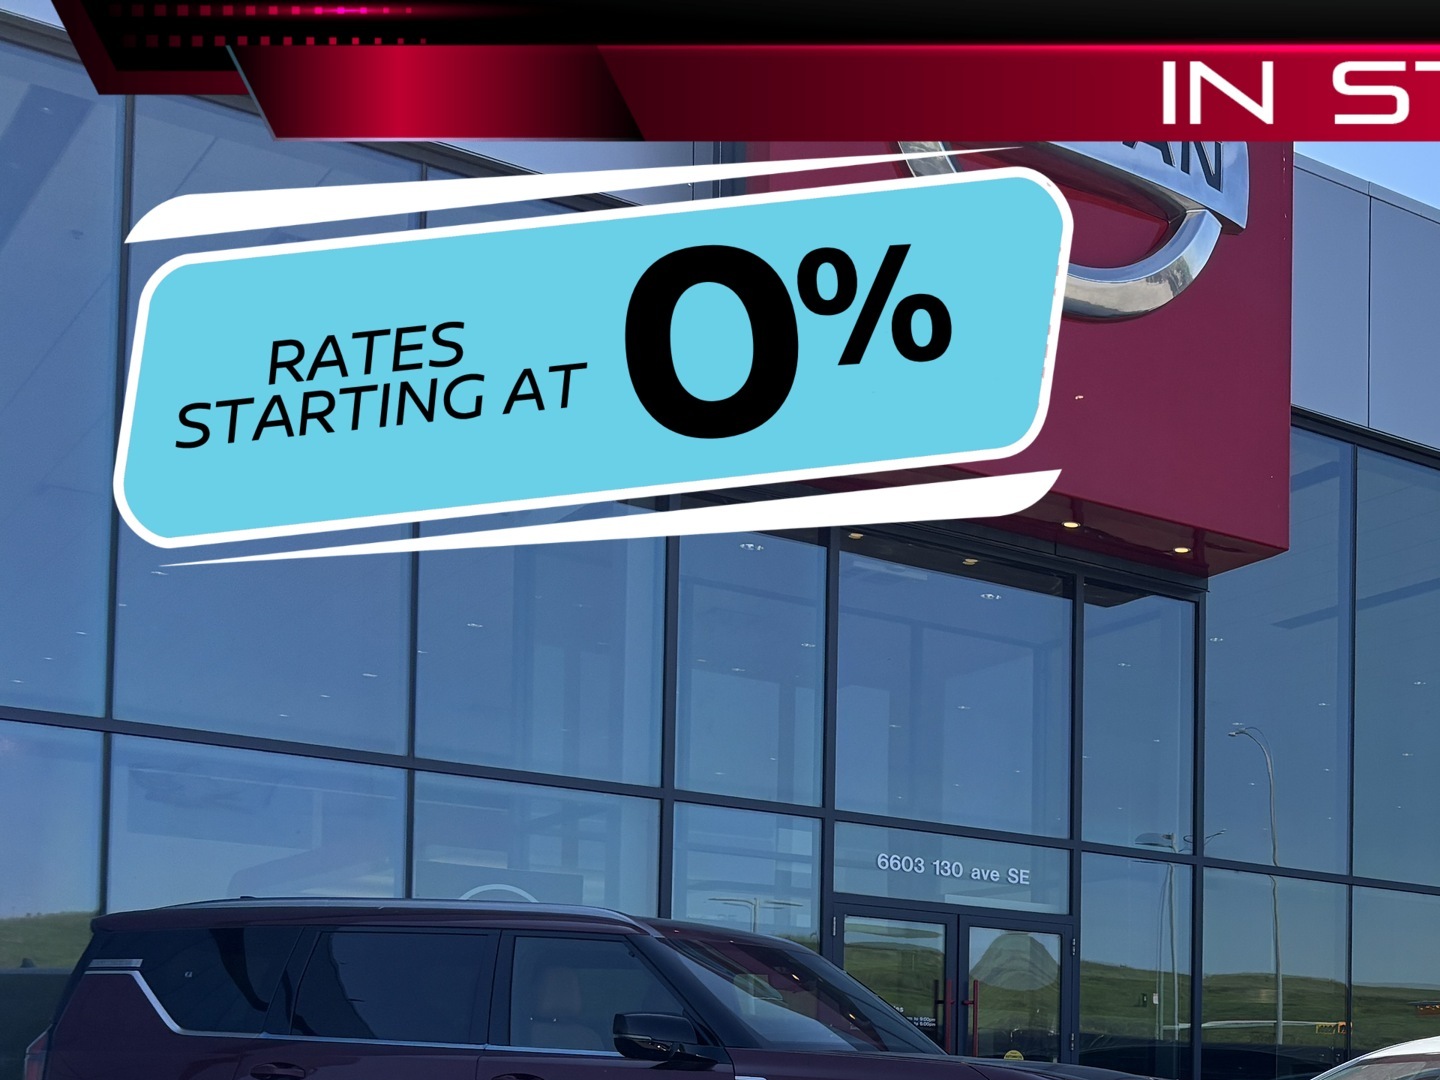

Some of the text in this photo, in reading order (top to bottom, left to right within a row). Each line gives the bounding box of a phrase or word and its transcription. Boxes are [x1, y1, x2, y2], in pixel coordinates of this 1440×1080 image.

[877, 853, 1030, 885] 6603 130 ave SE
